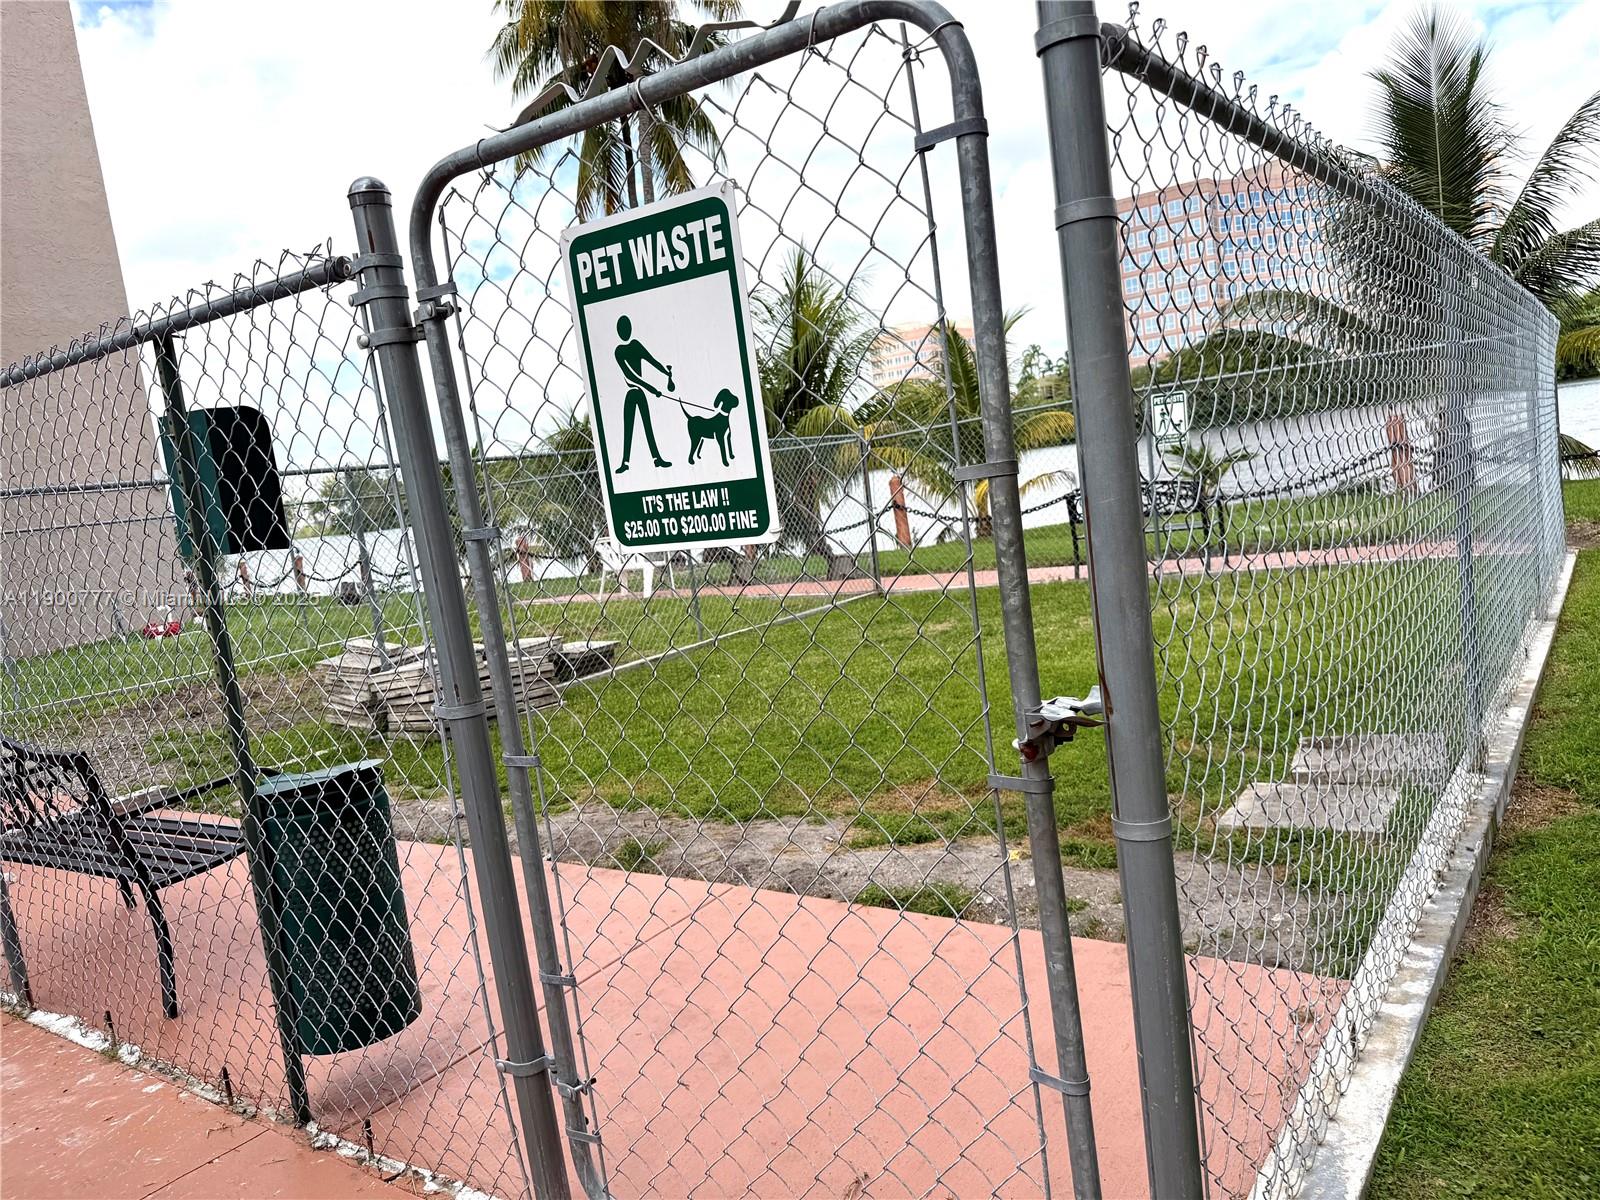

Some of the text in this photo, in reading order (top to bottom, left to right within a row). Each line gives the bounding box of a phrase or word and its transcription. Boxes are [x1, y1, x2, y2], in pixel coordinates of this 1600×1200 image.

[576, 214, 727, 294] PET WASTE
[642, 487, 729, 514] IT'S THE LAW !!
[624, 509, 759, 540] $25.00 TO $200.00 FINE
